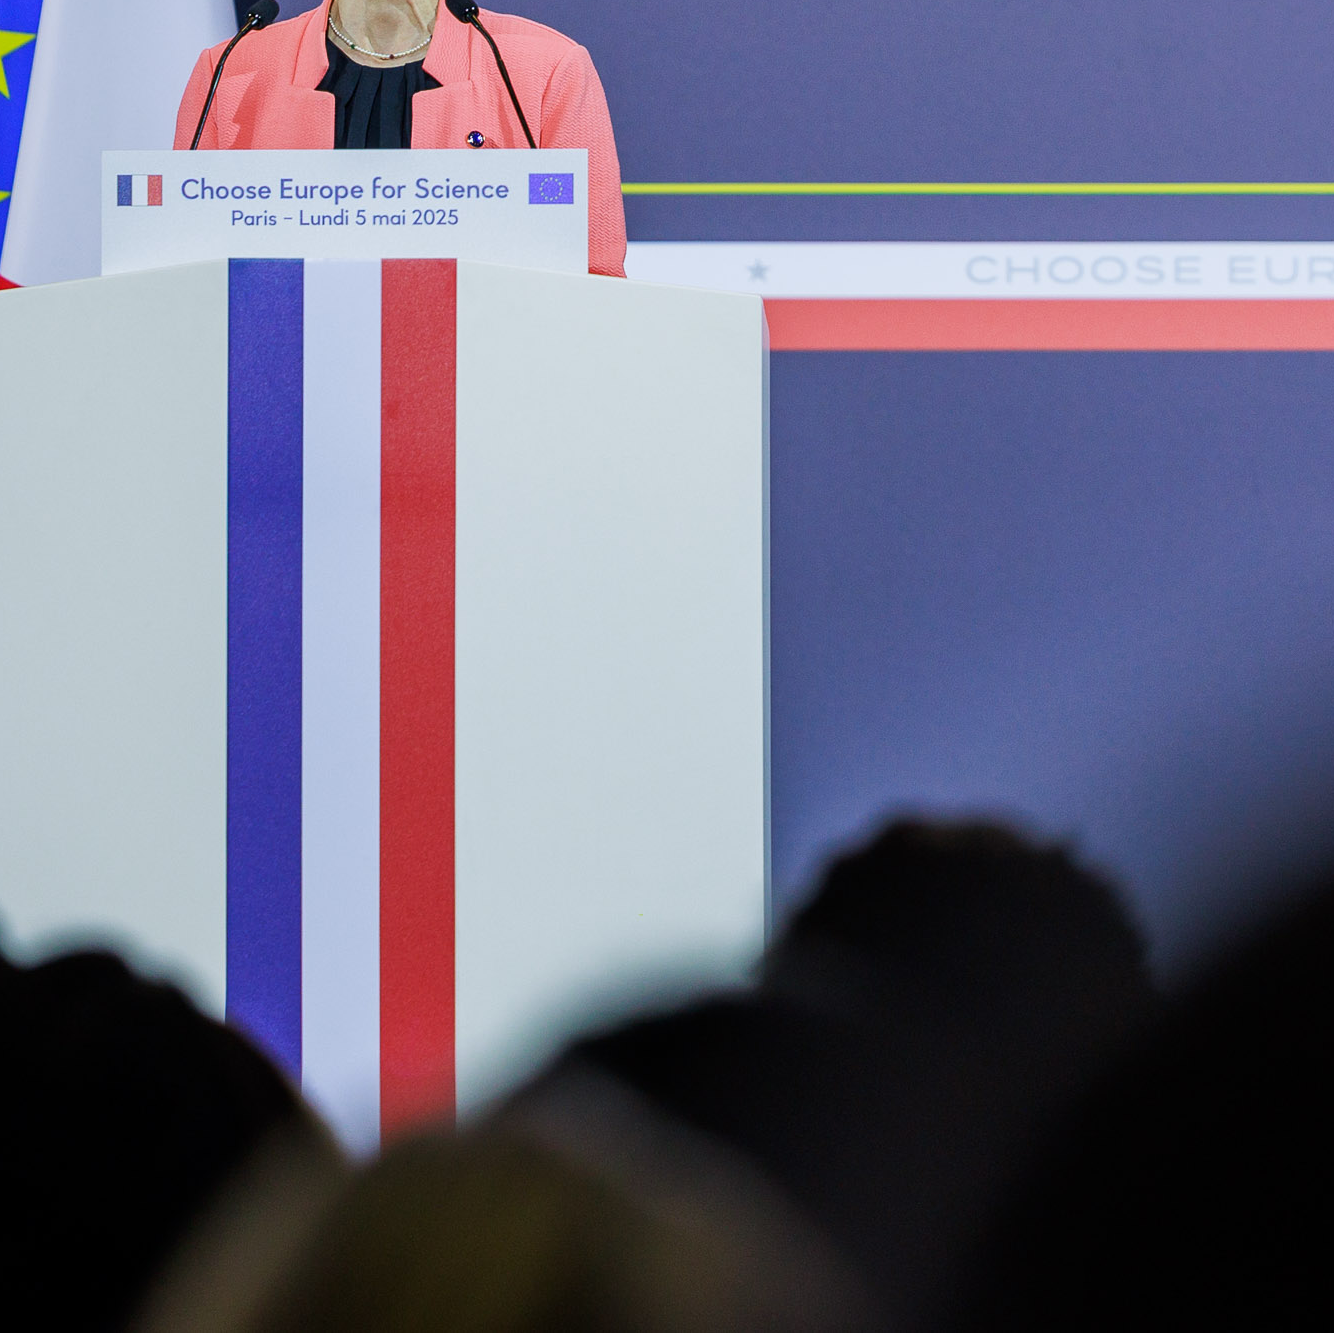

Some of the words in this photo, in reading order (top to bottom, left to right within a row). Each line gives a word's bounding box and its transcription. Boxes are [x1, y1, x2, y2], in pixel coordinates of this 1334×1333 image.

[180, 177, 272, 200] Choose
[279, 178, 364, 206] Europe
[372, 176, 407, 200] for
[414, 177, 510, 200] Science
[231, 209, 278, 227] Paris
[299, 208, 349, 226] Lundi
[355, 209, 367, 226] 5
[372, 209, 406, 226] mai
[412, 209, 459, 226] 2025
[964, 254, 1203, 285] CHOOSE
